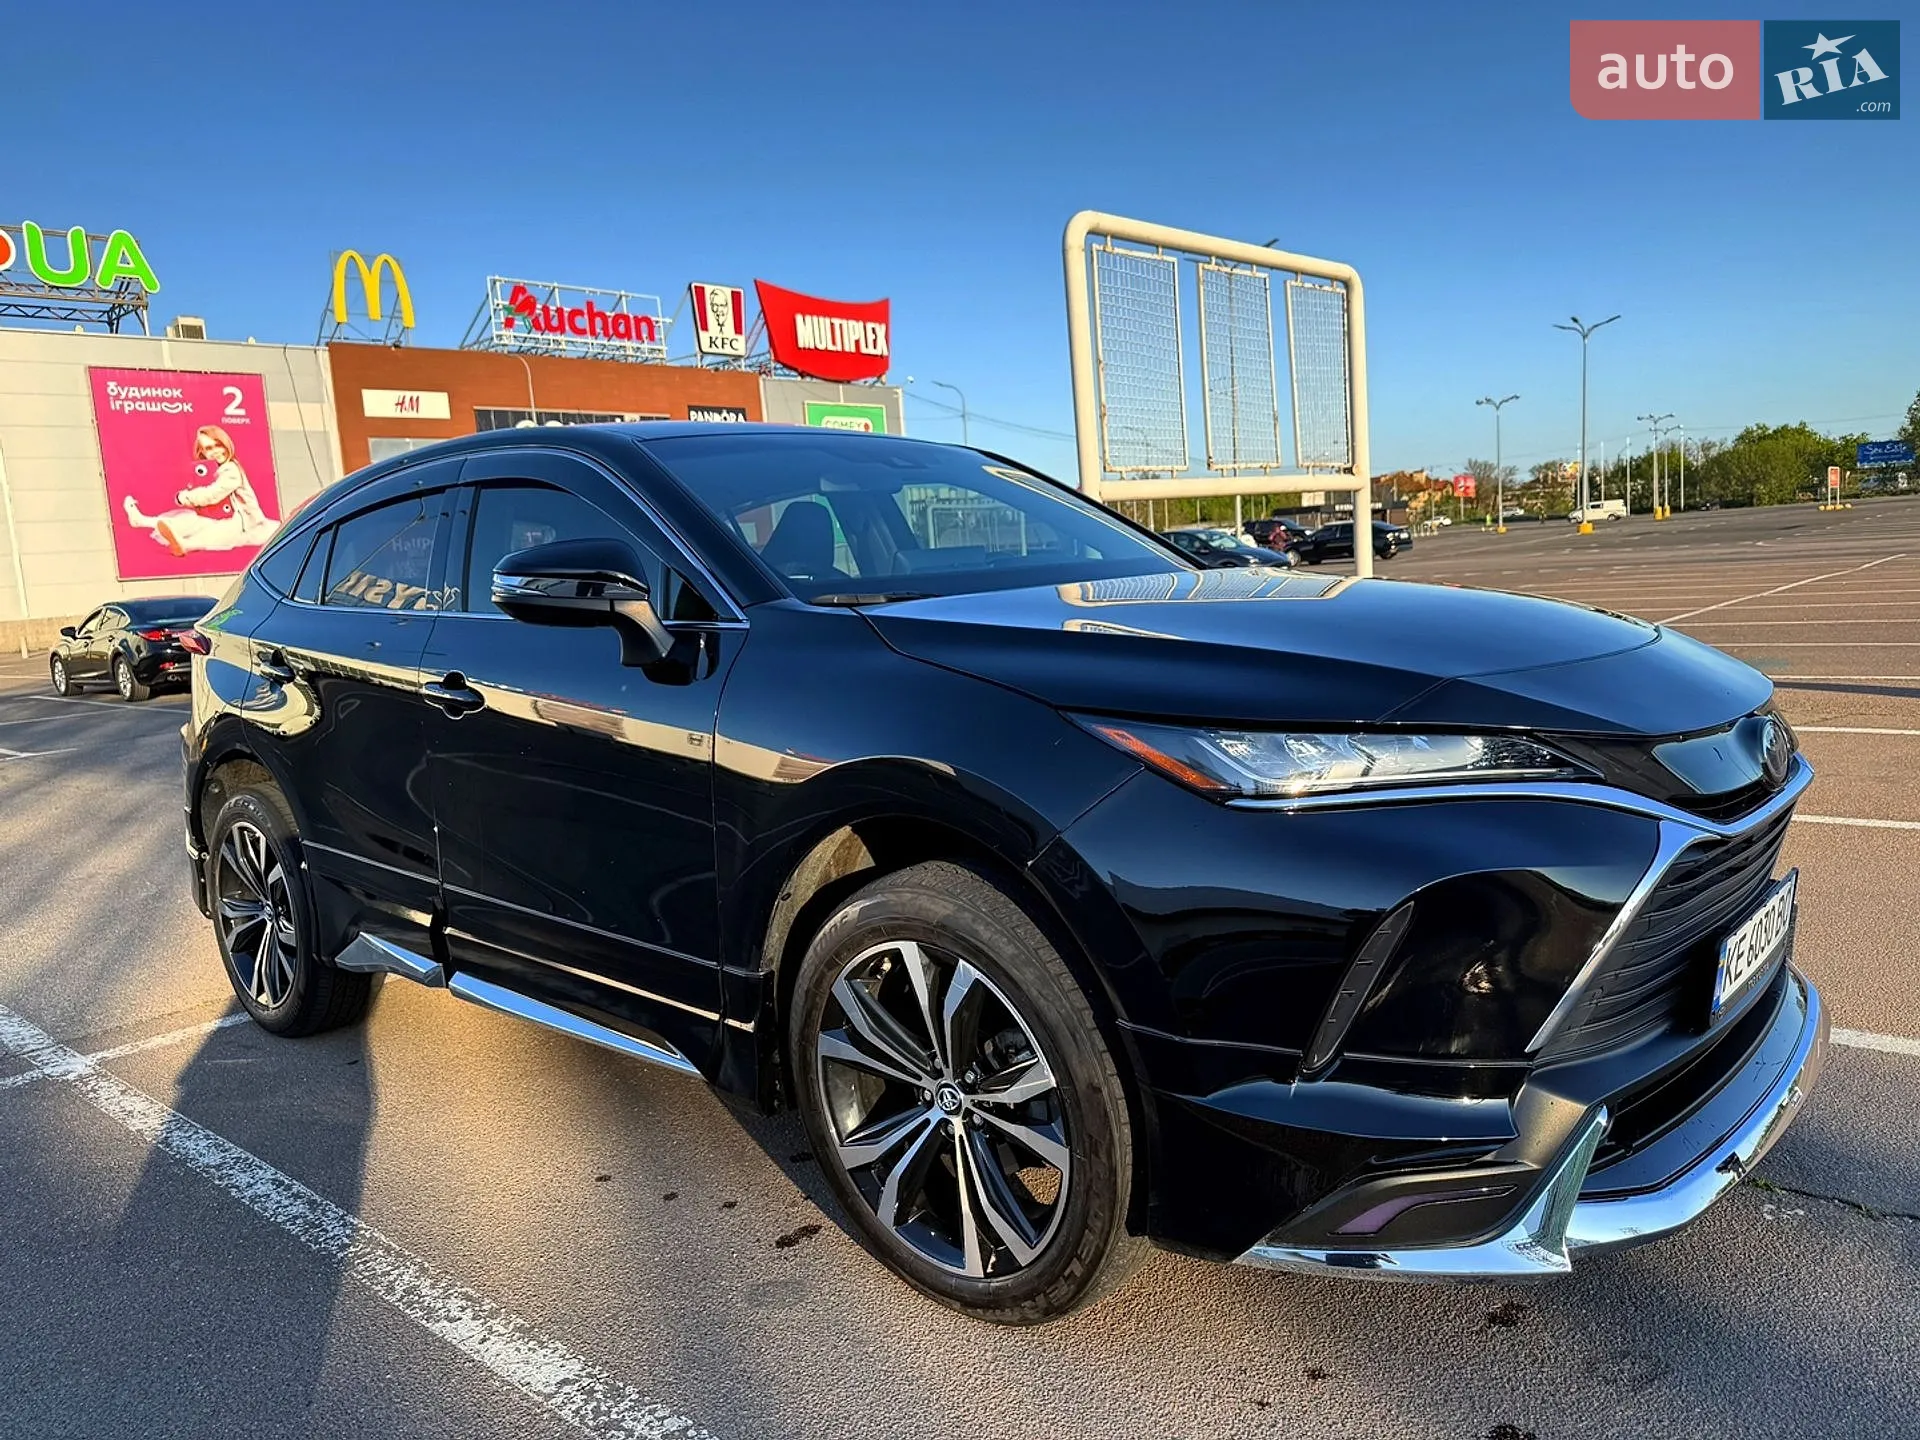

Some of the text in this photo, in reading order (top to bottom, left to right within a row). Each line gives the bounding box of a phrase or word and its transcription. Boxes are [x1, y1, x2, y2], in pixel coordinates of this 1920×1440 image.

[503, 282, 656, 343] Auchan
[709, 335, 740, 352] KFC
[794, 313, 889, 357] MULTIPLEX
[106, 381, 184, 399] будинок
[222, 386, 247, 416] 2
[689, 409, 746, 424] PANDORA
